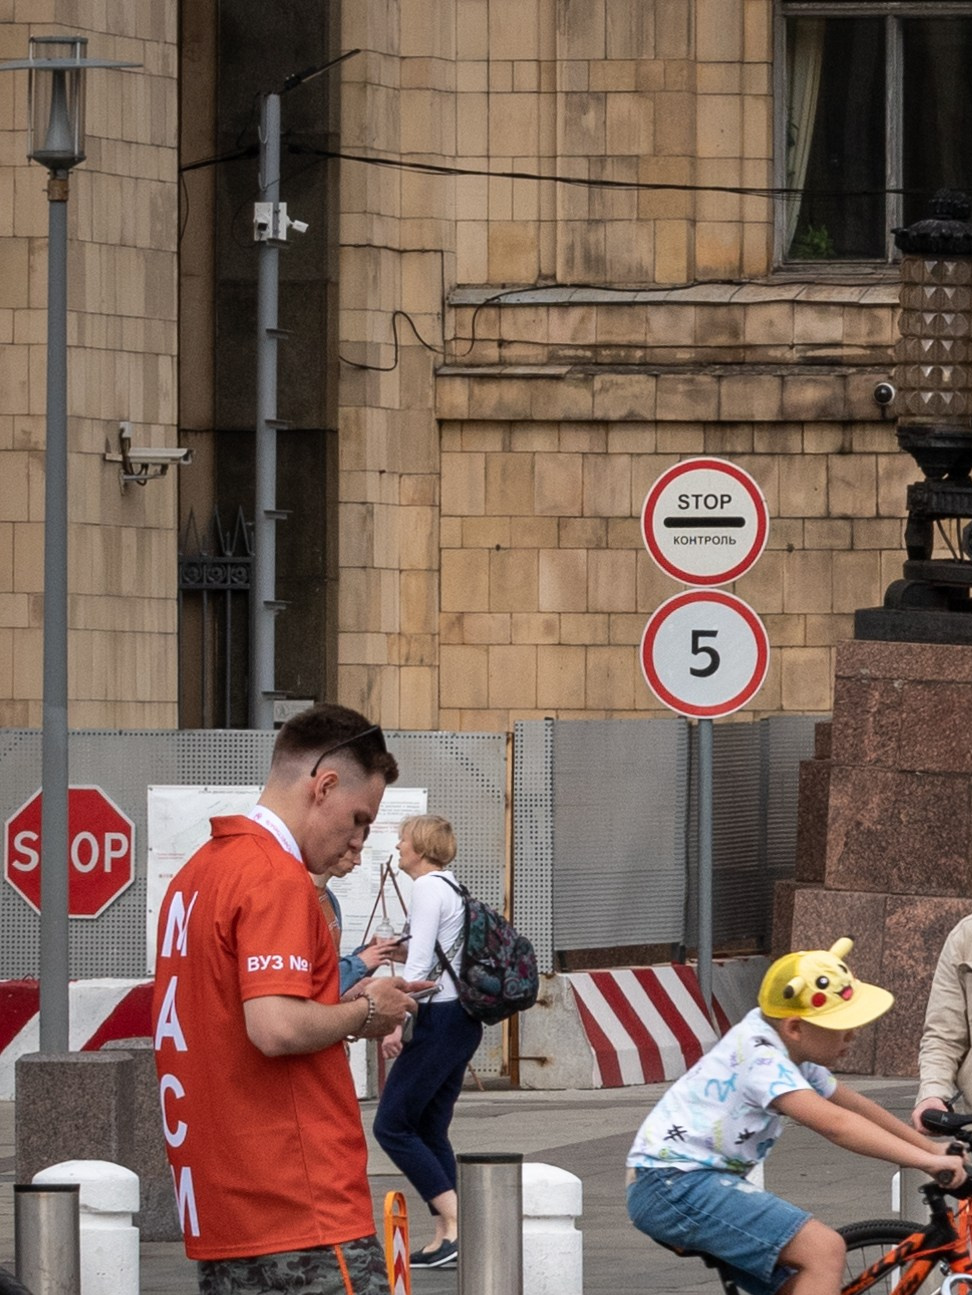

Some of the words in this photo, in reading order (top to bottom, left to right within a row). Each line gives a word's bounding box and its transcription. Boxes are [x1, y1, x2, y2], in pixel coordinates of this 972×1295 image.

[677, 493, 732, 510] STOP
[673, 535, 737, 546] КОНТРОЛЬ
[689, 629, 721, 678] 5
[12, 830, 129, 873] SOP
[247, 955, 284, 972] ВУЗ
